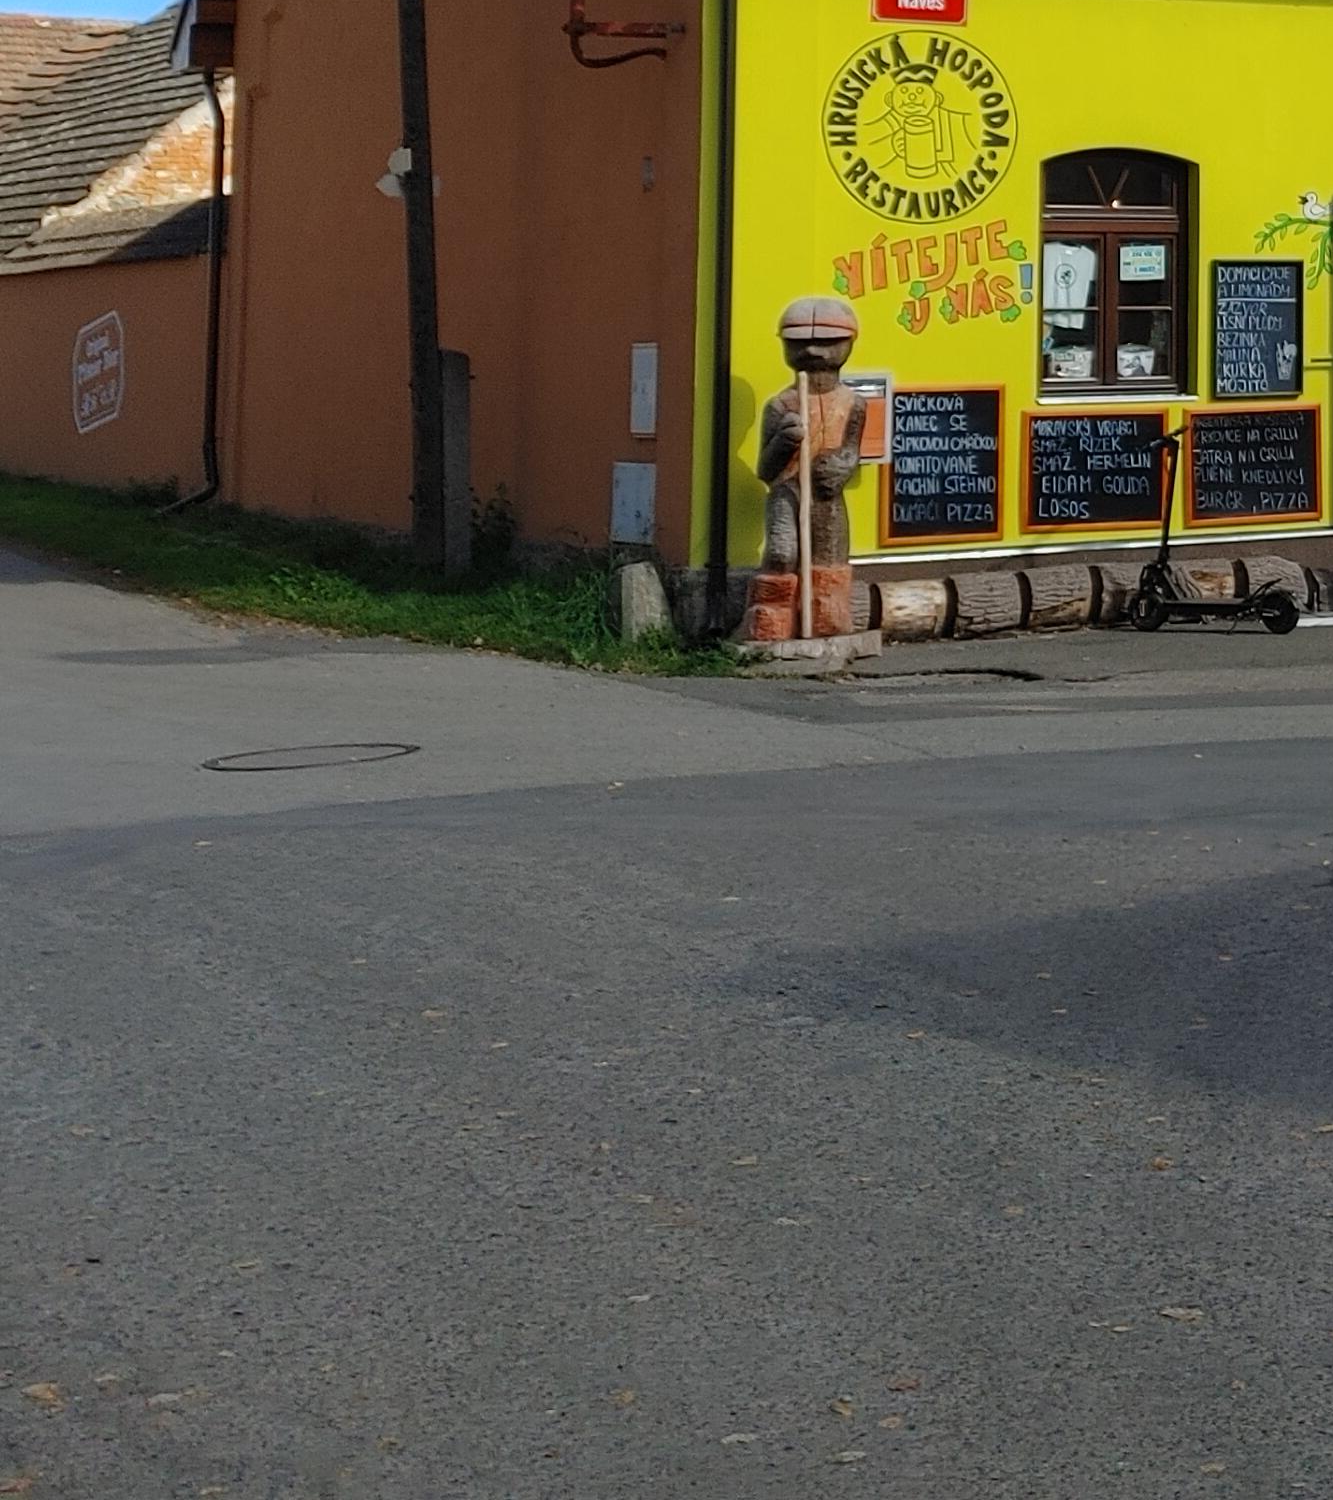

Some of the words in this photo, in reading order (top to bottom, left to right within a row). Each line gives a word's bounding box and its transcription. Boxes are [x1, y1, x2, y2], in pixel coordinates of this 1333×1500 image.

[827, 33, 911, 148] HRUSICKÁ
[924, 36, 1011, 148] HOSPODA
[843, 157, 1000, 220] RESTAURACE
[833, 220, 1010, 300] VÍTEJTE
[901, 299, 930, 334] U
[1217, 378, 1269, 393] MOJITO
[895, 414, 938, 432] KANEC
[949, 413, 968, 432] SE
[1246, 428, 1261, 443] NA
[944, 475, 996, 494] STEHNO
[1102, 475, 1151, 496] GOUDA
[1038, 497, 1090, 519] LOSOS
[1260, 491, 1310, 510] PIZZA
[946, 502, 995, 523] PIZZA
